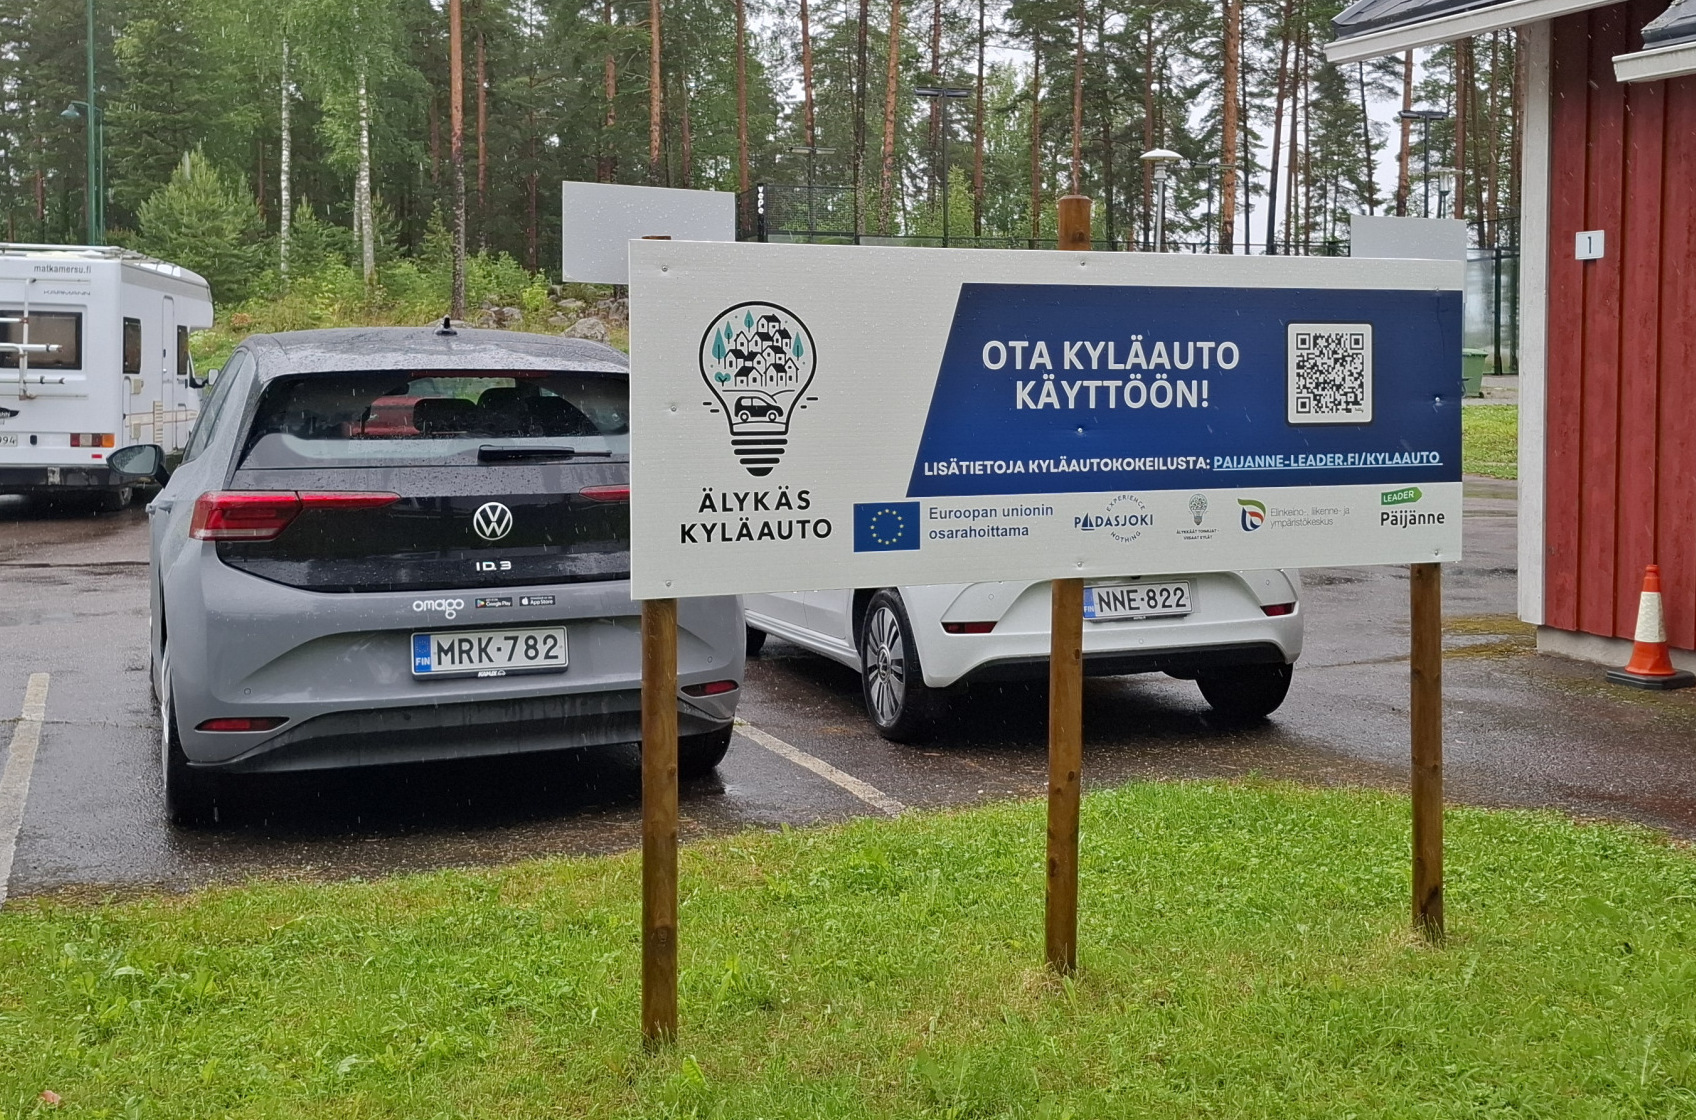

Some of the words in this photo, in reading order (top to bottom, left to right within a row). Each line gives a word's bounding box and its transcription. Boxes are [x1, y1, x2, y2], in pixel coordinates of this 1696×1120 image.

[1587, 236, 1592, 254] 1
[33, 265, 91, 274] matkamersu.fi
[982, 340, 1053, 370] OTA
[1063, 334, 1240, 370] KYLÄAUTO
[1016, 373, 1209, 409] KÄYTTÖÖN!
[0, 436, 15, 445] 94
[924, 458, 1025, 476] LISÄTIETOJA
[1029, 456, 1210, 474] KYLÄAUTOKOKEILUSTA:
[1213, 451, 1441, 470] PAIJANNE-LEADER.FI/KYLAAUTO
[698, 485, 811, 513] ÄLYKÄS
[1106, 494, 1146, 512] EXPERIENCE
[1383, 490, 1415, 503] LEADER
[929, 505, 997, 522] Euroopan
[1002, 504, 1054, 518] unionin
[1270, 507, 1309, 517] Elinkeino-,
[1311, 507, 1342, 516] liikenne-
[1343, 507, 1350, 516] ja
[1380, 510, 1446, 528] Päijänne
[680, 516, 832, 544] KYLÄAUTO
[929, 525, 1029, 540] osarahoittama
[1270, 518, 1334, 529] ympäristökeskus
[1110, 530, 1141, 543] NOTHING
[1097, 586, 1187, 612] NNE-822
[412, 599, 464, 620] omago
[436, 634, 559, 665] MRK-782
[415, 657, 431, 666] FIN
